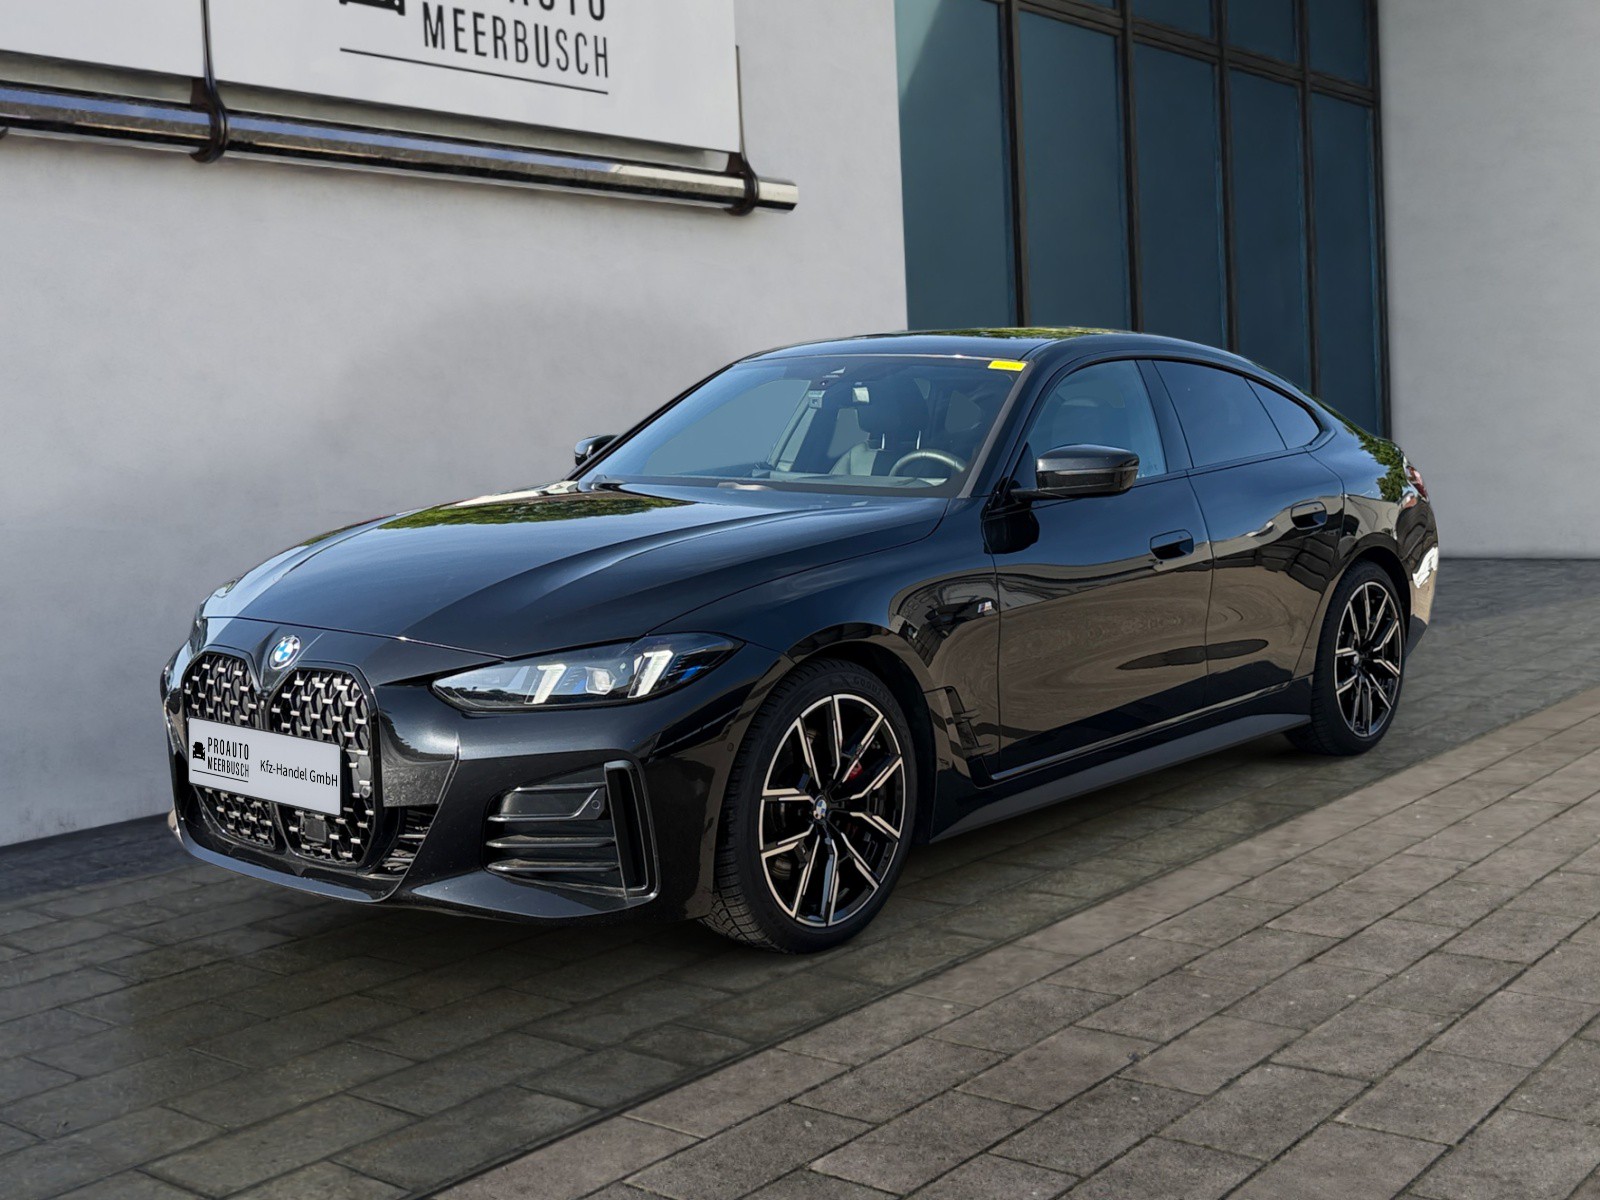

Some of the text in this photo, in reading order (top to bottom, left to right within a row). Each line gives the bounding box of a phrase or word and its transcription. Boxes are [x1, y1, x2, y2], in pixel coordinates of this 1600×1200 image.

[422, 1, 608, 78] MEERBUSCH
[207, 736, 249, 760] PROAUTO
[260, 759, 338, 787] Kfz-Handel GmbH
